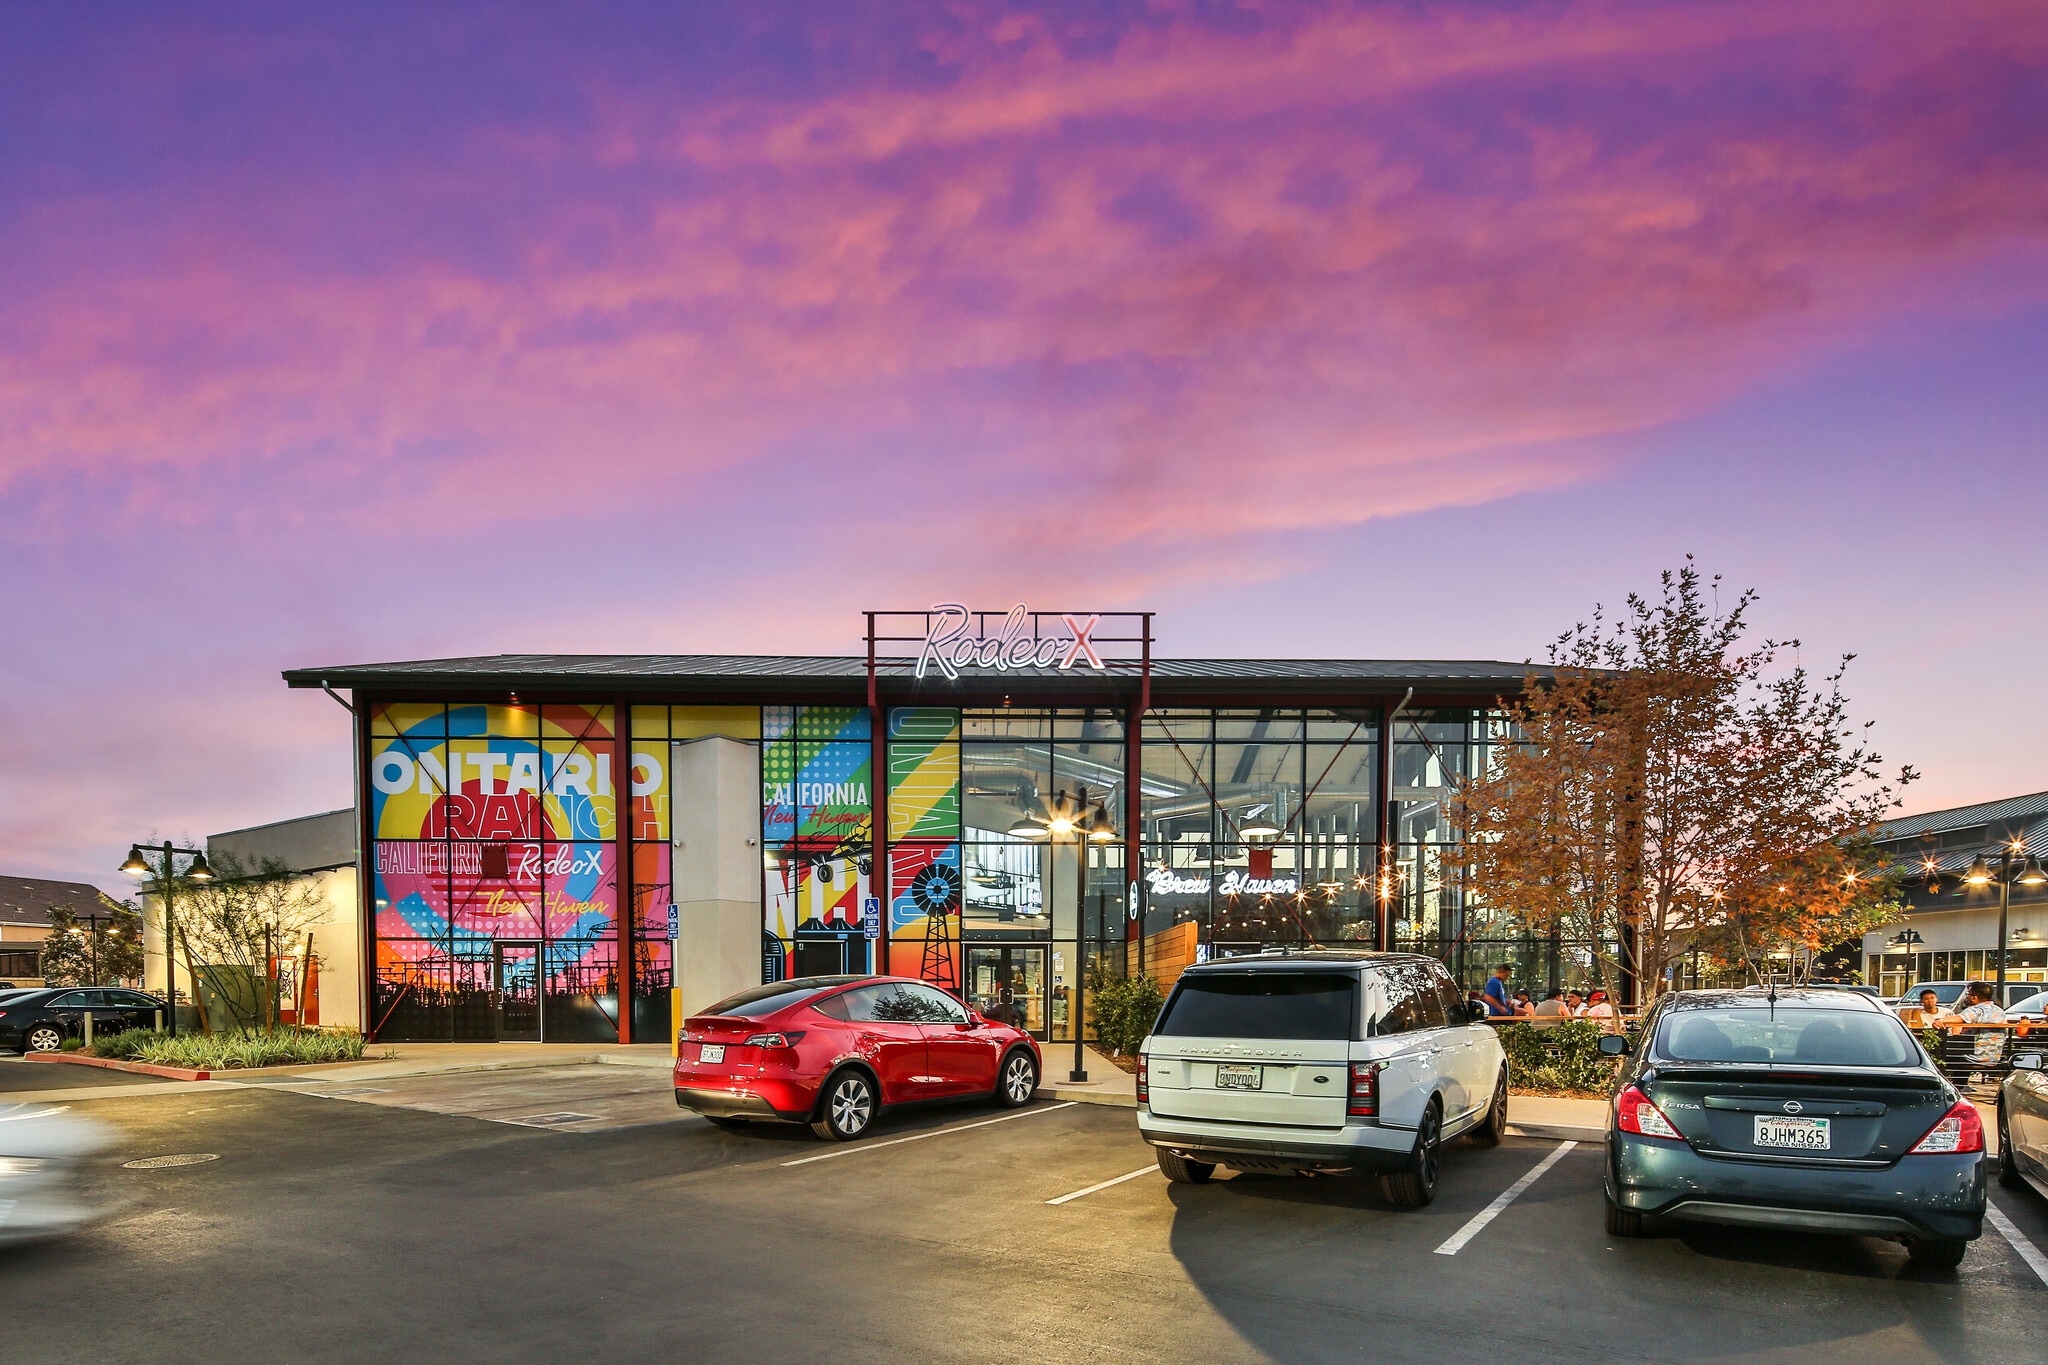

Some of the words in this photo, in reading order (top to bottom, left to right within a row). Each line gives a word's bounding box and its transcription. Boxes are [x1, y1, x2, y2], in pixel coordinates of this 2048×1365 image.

[915, 601, 1106, 680] RodeoX
[371, 751, 663, 796] ONTARIO
[763, 782, 868, 806] CALIFORNIA
[430, 793, 670, 841] RANCH
[763, 804, 799, 826] New
[801, 804, 869, 828] Haven
[516, 843, 604, 882] RodeoX
[1145, 869, 1211, 895] Brew
[1218, 870, 1297, 895] Haven
[476, 888, 531, 917] New
[530, 890, 610, 919] Haven
[1179, 1047, 1232, 1055] RANGE
[1243, 1049, 1302, 1057] ROVER
[1760, 1127, 1824, 1144] 8JHM365
